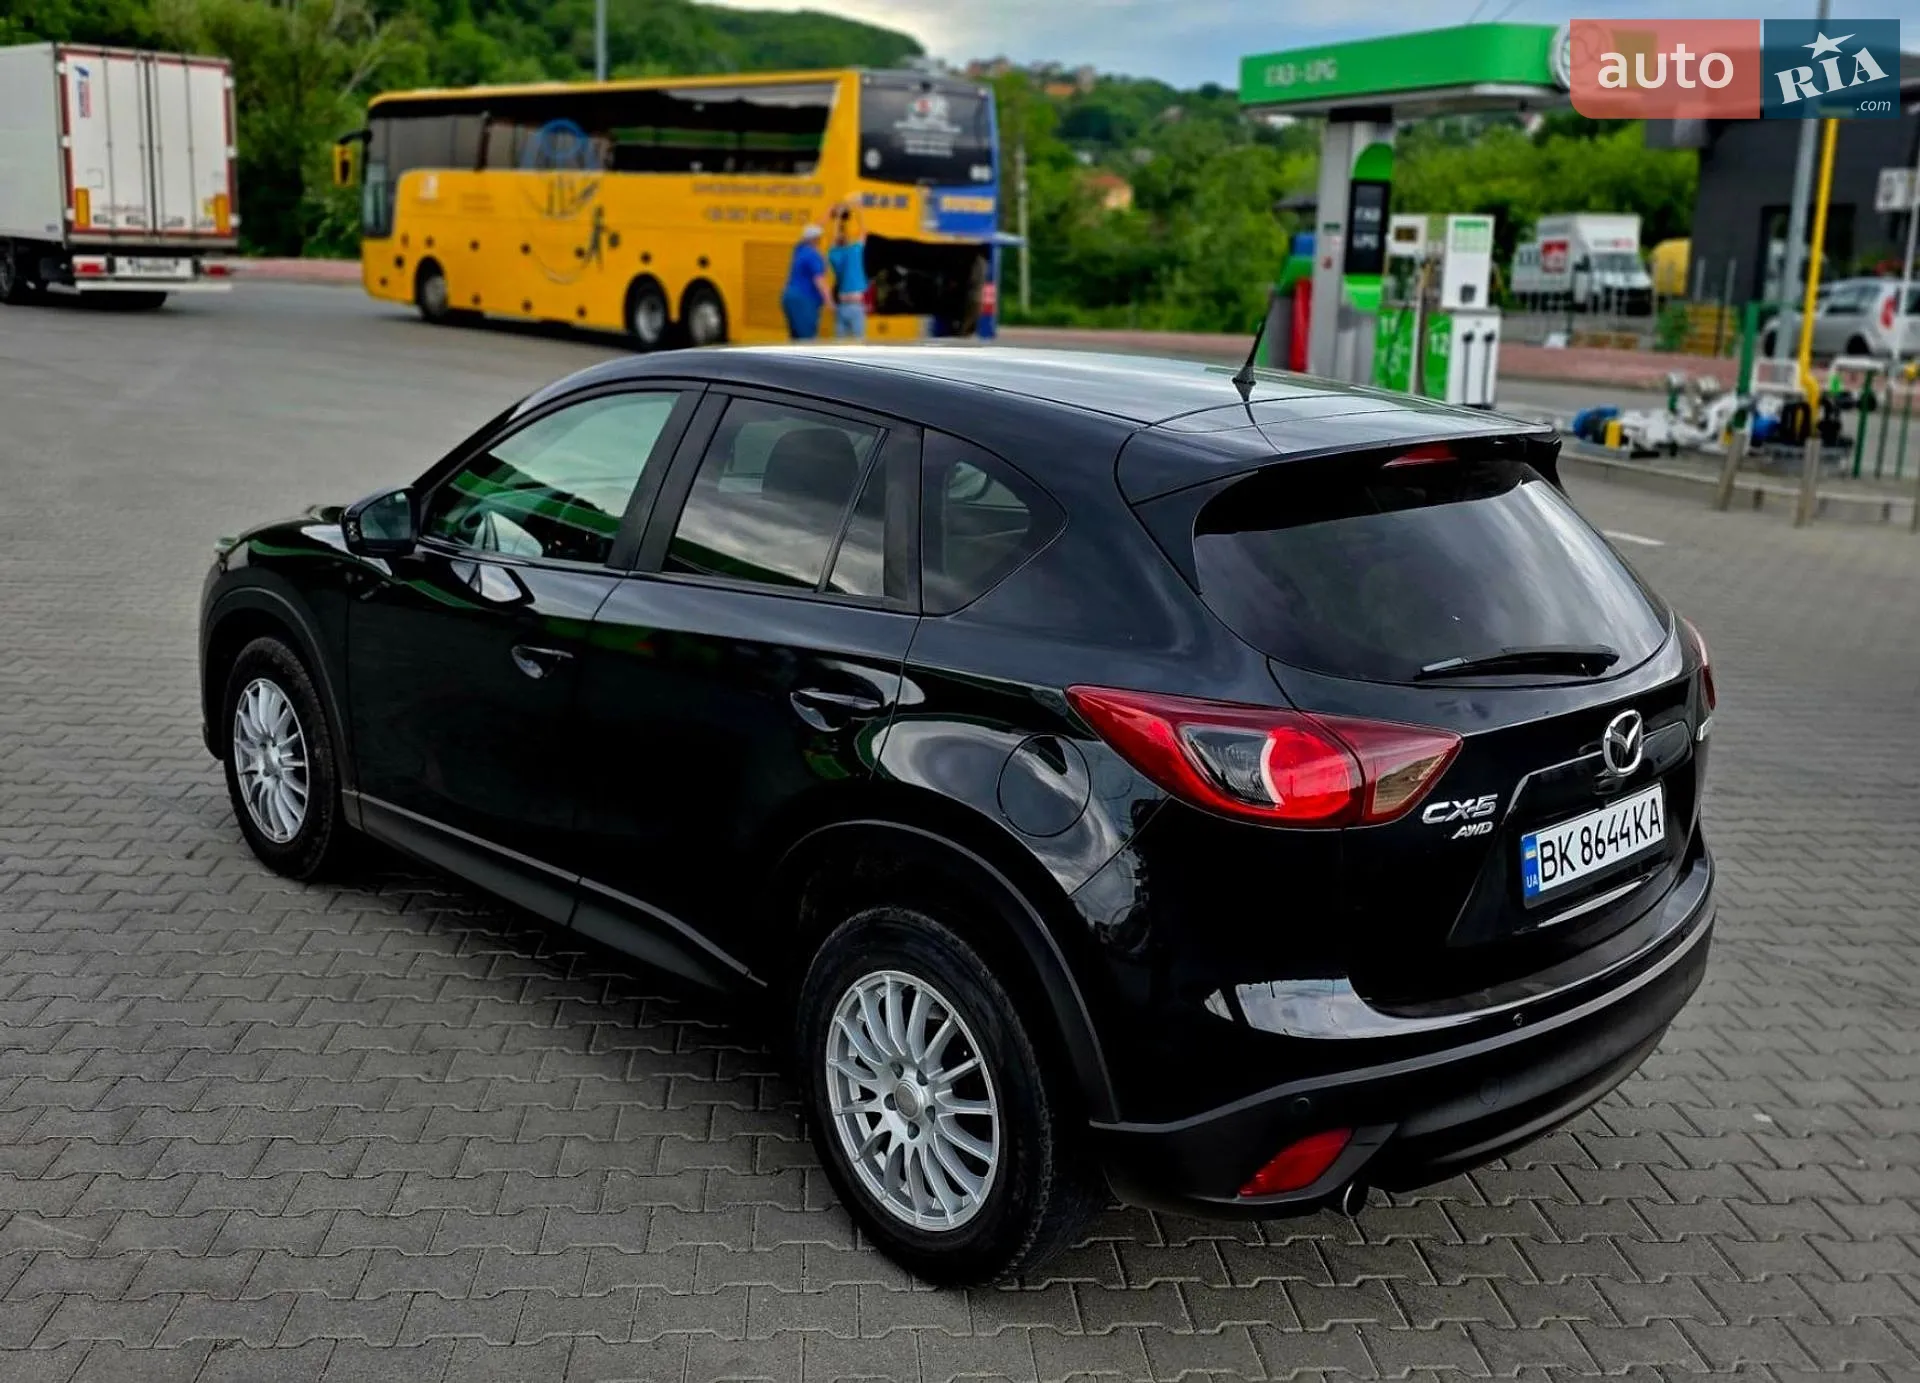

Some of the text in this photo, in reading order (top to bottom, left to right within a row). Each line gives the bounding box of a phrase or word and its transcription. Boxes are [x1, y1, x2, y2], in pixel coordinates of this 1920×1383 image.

[1421, 793, 1498, 825] CX-5
[1451, 820, 1494, 840] AWD
[1526, 874, 1539, 889] UA
